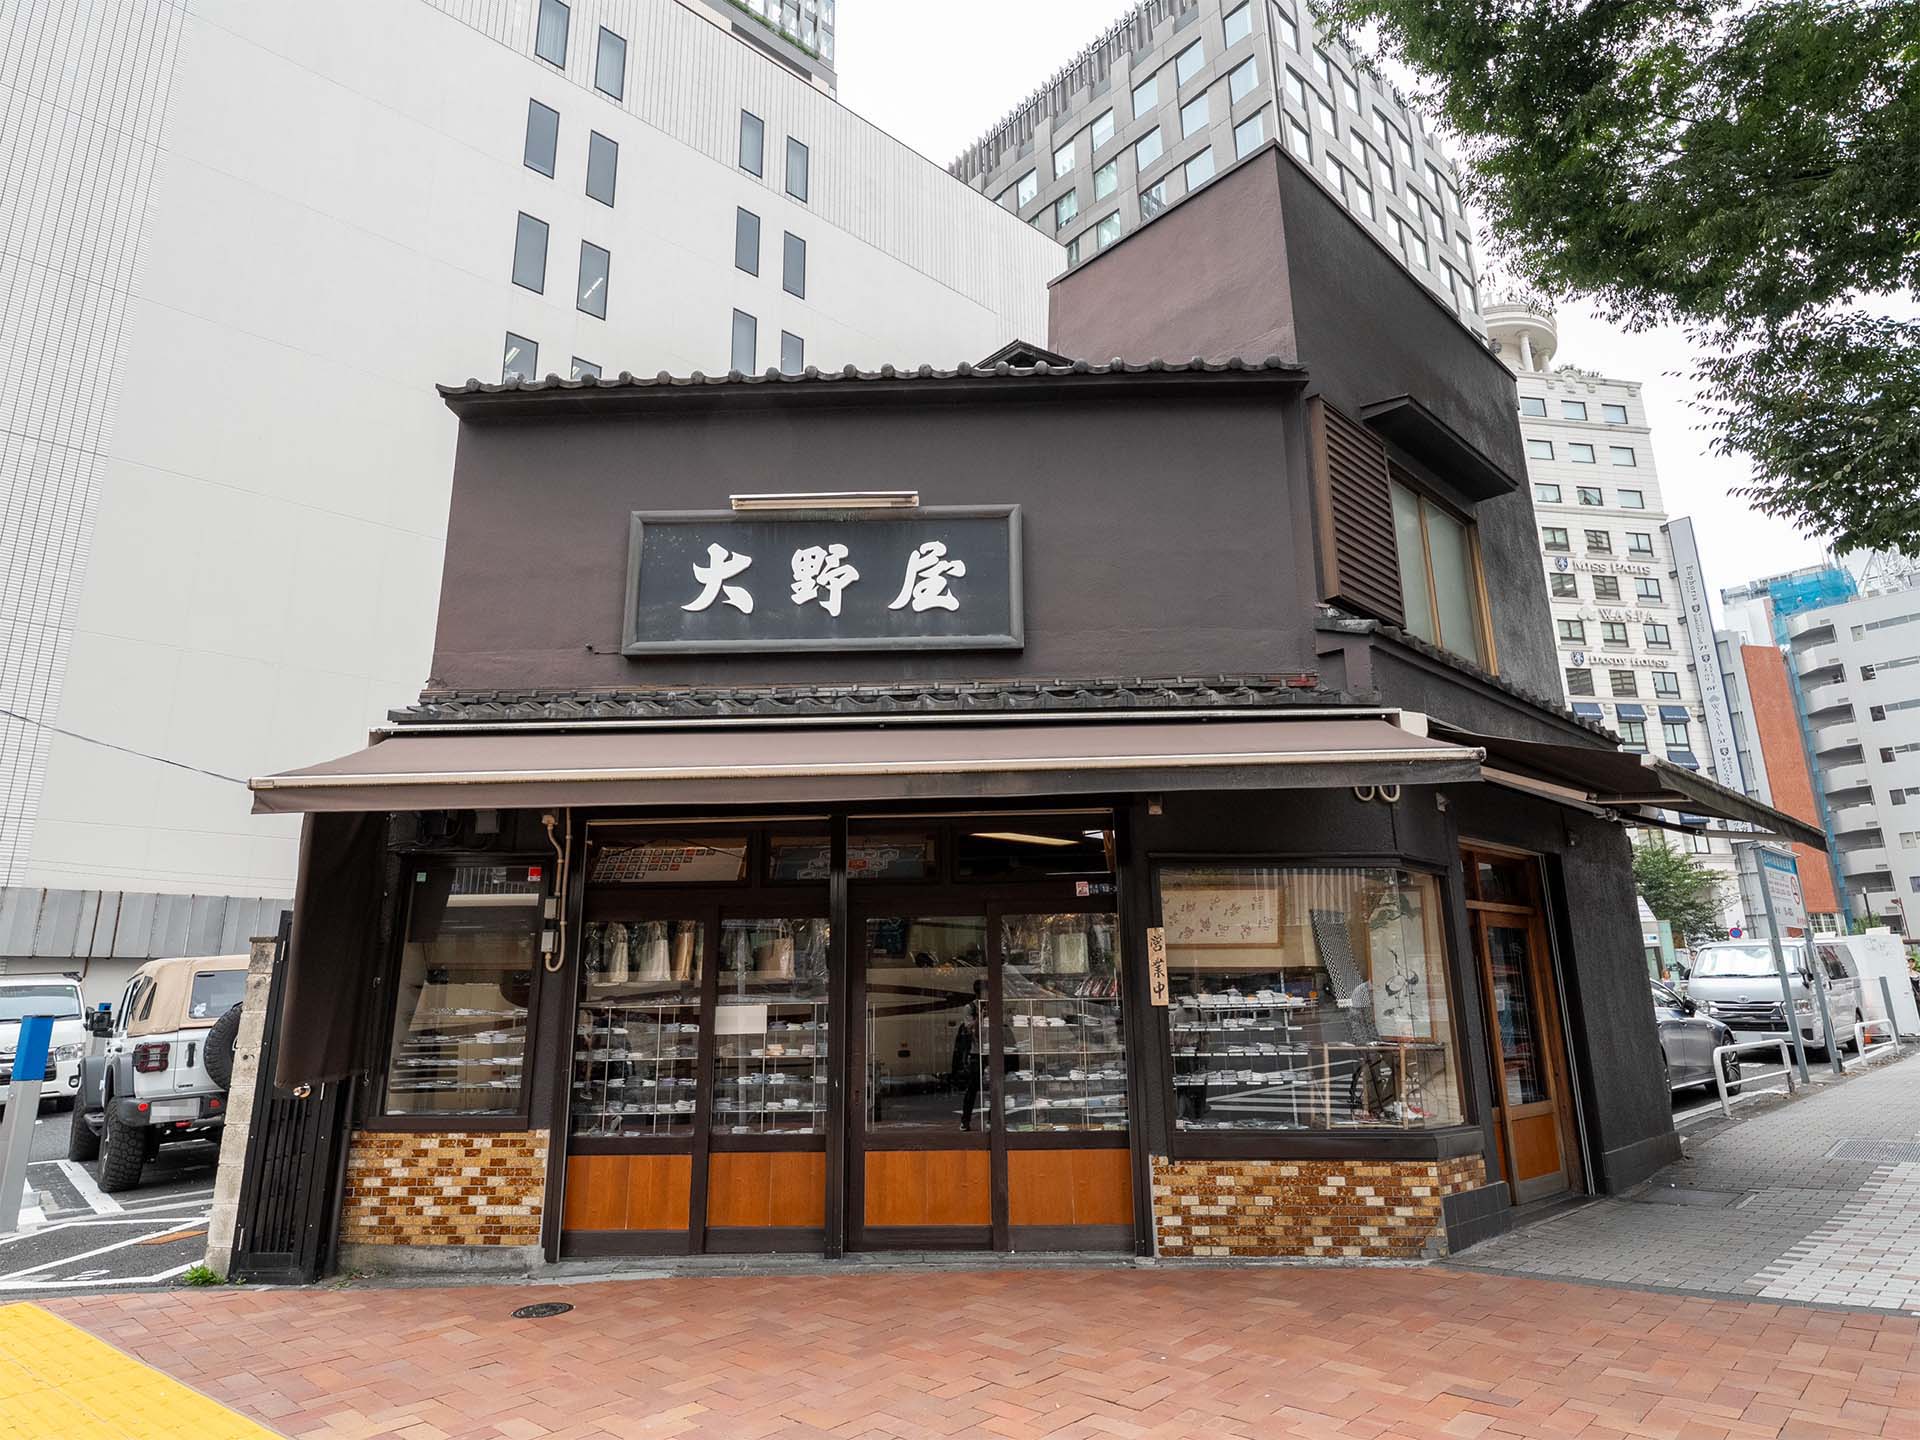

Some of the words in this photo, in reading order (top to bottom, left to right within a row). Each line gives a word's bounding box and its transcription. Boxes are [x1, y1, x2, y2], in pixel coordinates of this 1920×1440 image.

[982, 91, 1041, 149] Millennium
[1047, 50, 1086, 93] Mitsui
[1089, 10, 1138, 55] Garden
[680, 541, 967, 617] 大野屋
[1572, 560, 1607, 574] MISS
[1611, 562, 1651, 576] PARIS
[1589, 655, 1627, 666] DANDY
[1630, 657, 1670, 668] HOUSE
[1150, 935, 1165, 999] 営業中
